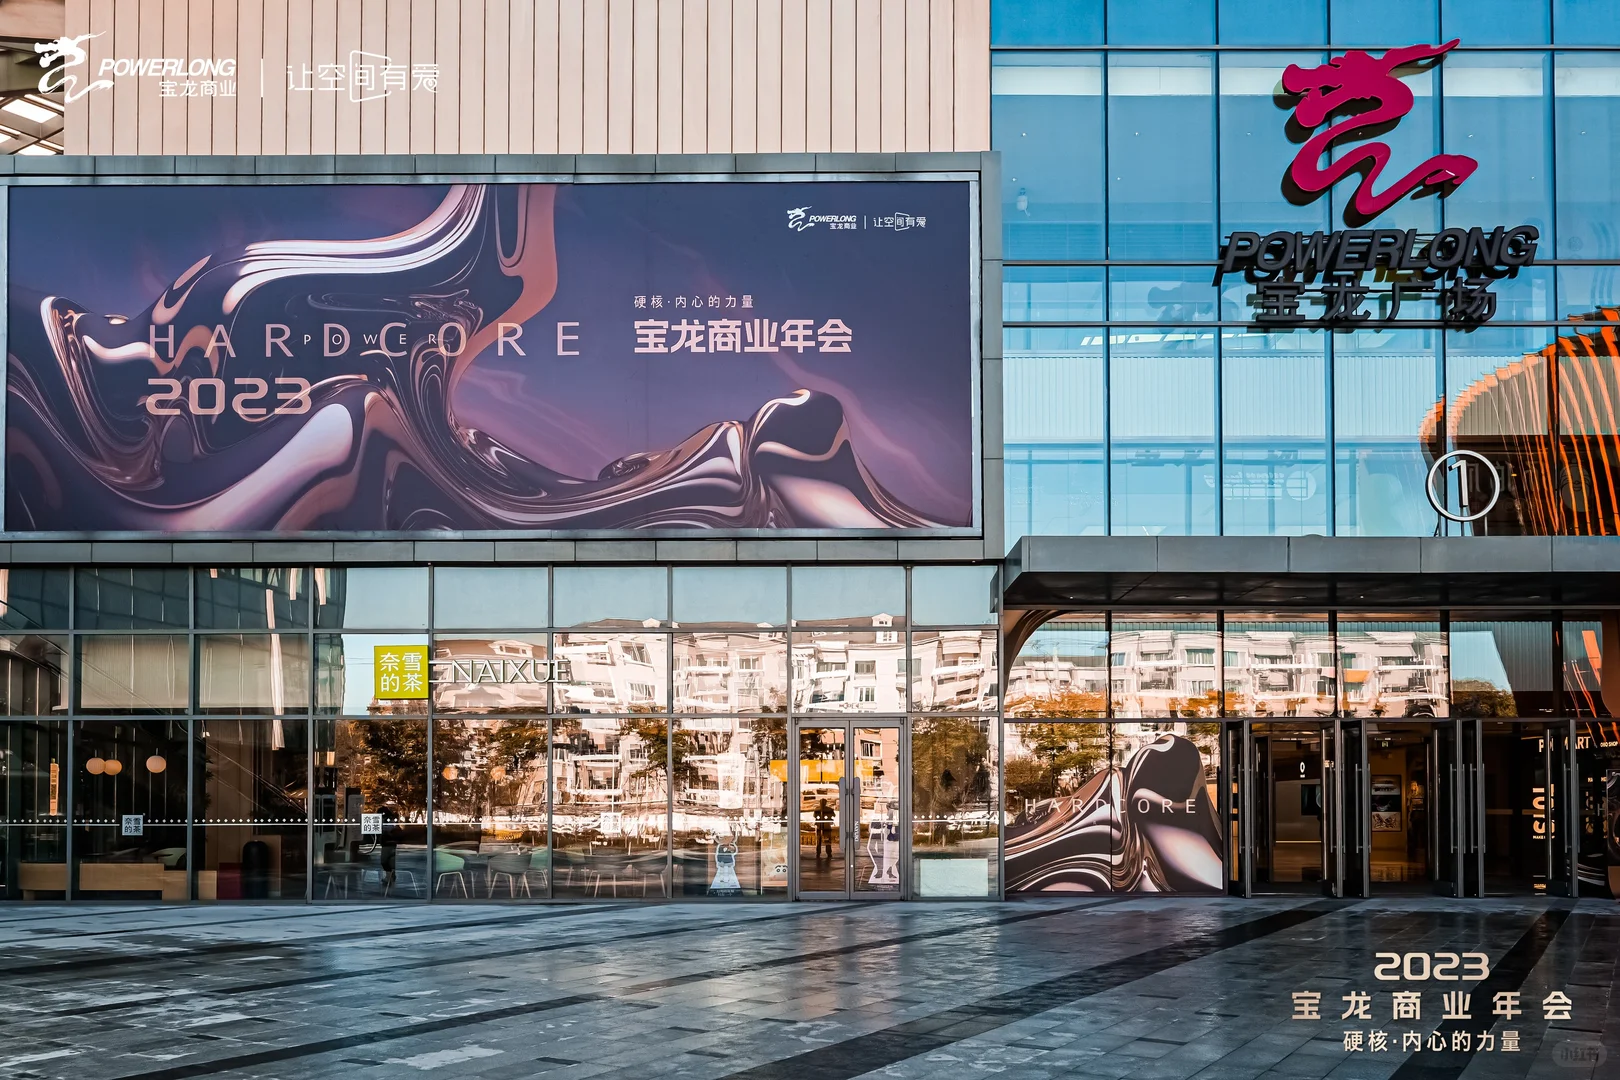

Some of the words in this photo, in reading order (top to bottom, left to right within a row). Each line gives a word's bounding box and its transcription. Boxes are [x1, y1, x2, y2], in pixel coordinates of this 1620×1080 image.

[808, 215, 857, 223] POWERLONG
[829, 222, 857, 230] 宝龙商业
[873, 215, 927, 228] 让空间有爱
[1222, 225, 1540, 274] POWERLONG
[1255, 275, 1498, 323] 宝龙广场
[148, 321, 581, 359] HARDCORE
[634, 318, 853, 353] 宝龙商业年会
[145, 377, 312, 416] 2023
[379, 652, 423, 672] 奈雪
[449, 659, 571, 683] NAIXUE
[380, 673, 423, 693] 的茶
